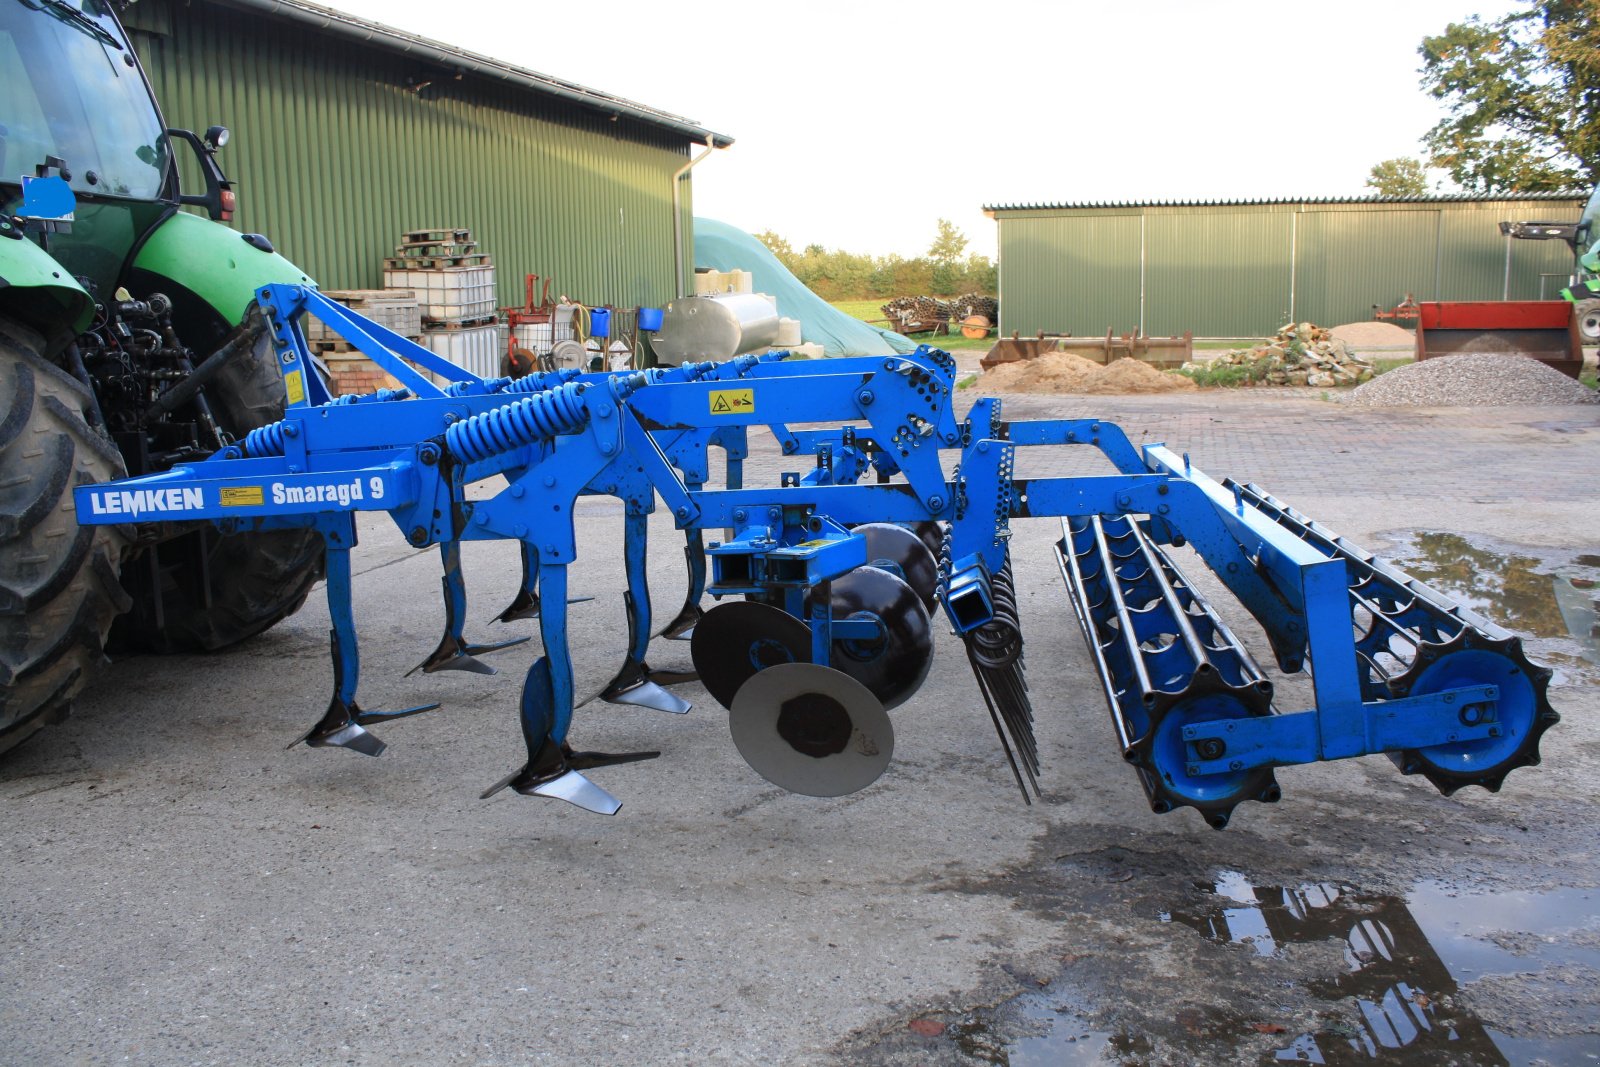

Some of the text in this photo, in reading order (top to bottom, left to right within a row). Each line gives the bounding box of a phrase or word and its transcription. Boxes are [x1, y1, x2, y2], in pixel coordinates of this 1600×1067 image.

[283, 351, 296, 363] CE
[91, 487, 204, 518] LEMKEN
[272, 478, 363, 506] Smaragd
[370, 476, 384, 499] 9
